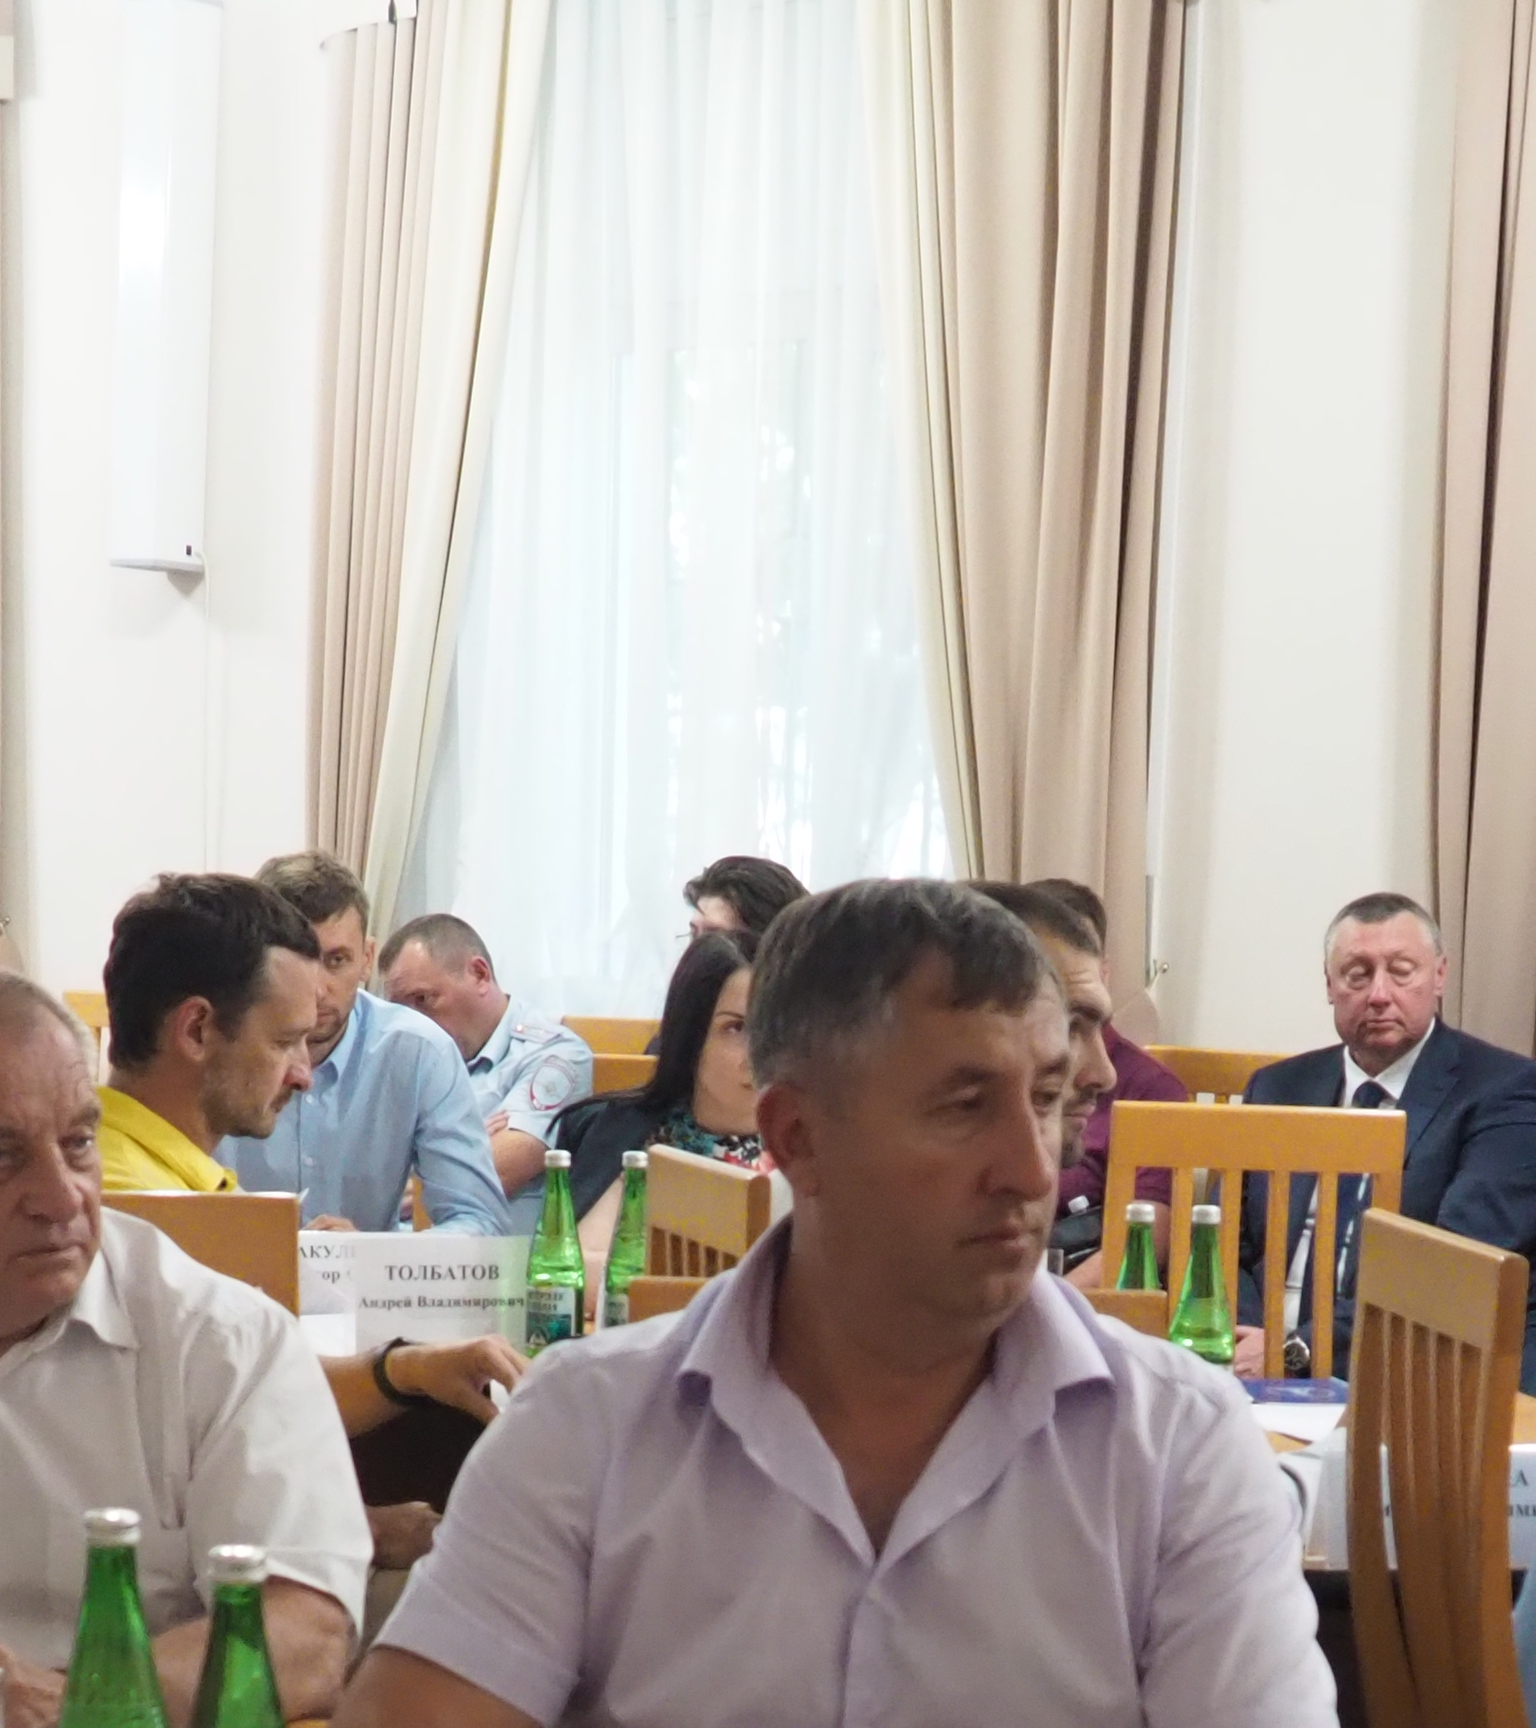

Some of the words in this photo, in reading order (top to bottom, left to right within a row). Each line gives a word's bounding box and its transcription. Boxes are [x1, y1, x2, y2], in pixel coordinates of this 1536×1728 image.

[384, 1264, 500, 1282] ТОЛБАТОВ
[358, 1295, 413, 1310] Андрей
[417, 1295, 525, 1310] Владимирович
